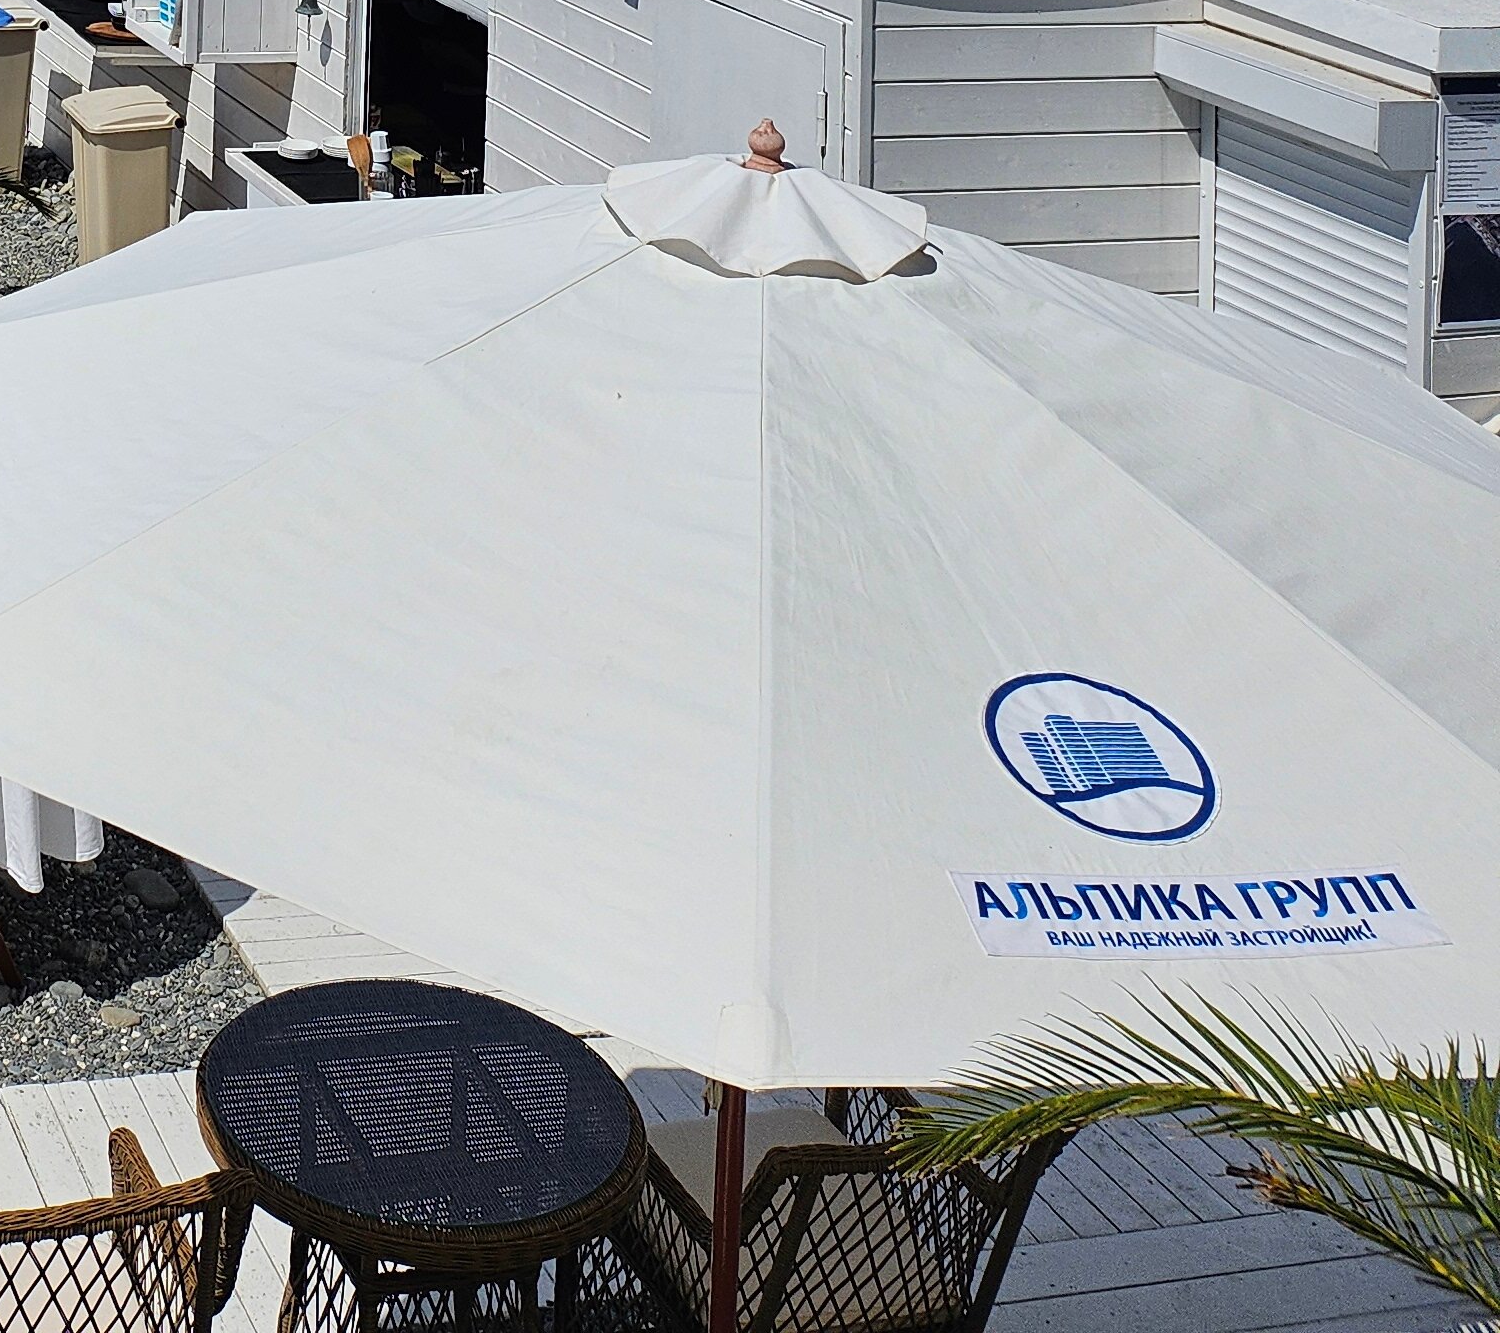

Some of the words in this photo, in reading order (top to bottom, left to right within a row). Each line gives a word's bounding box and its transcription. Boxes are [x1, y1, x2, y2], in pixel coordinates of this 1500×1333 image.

[973, 881, 1236, 922] АЛЬПИКА
[1235, 872, 1418, 920] ГРУПП
[1046, 930, 1096, 948] ВАШ
[1100, 928, 1224, 951] НАДЕЖНЫЙ
[1229, 918, 1378, 947] ЗАСТРОЙЩИК!
